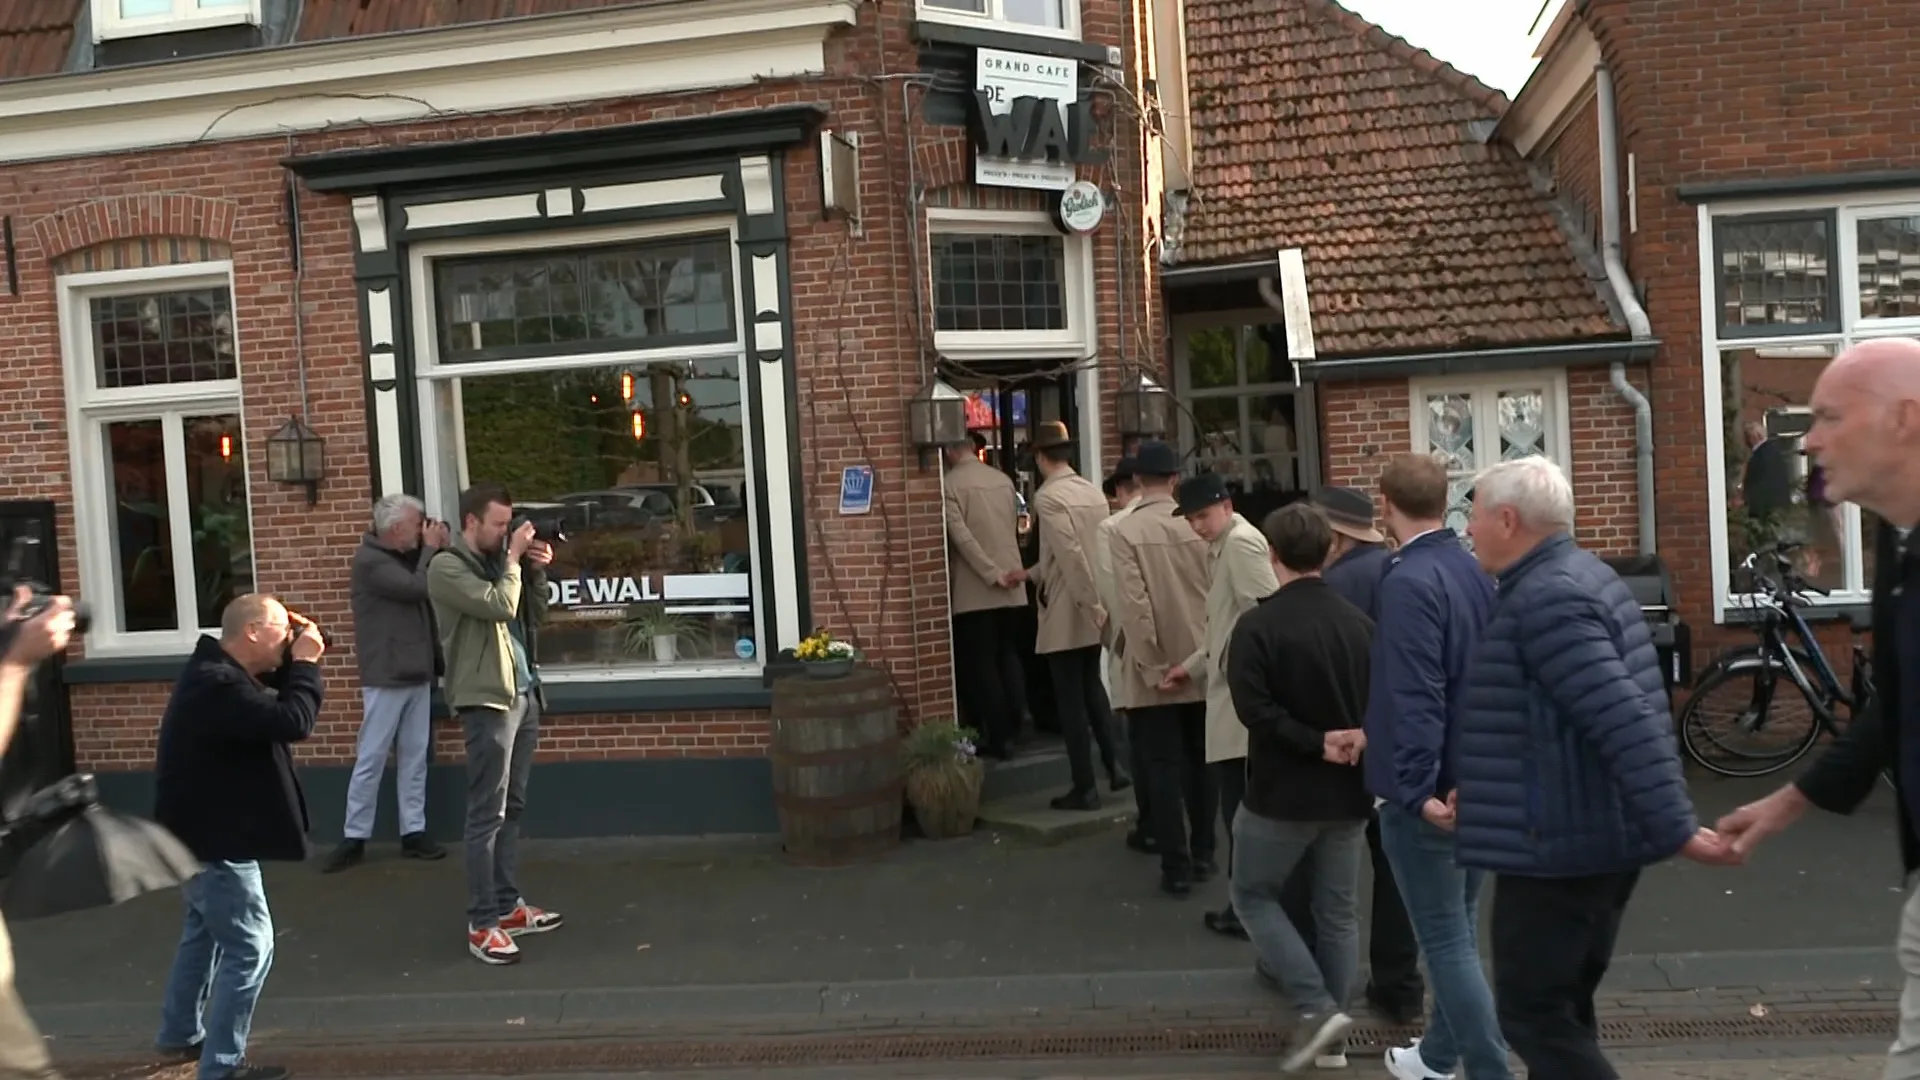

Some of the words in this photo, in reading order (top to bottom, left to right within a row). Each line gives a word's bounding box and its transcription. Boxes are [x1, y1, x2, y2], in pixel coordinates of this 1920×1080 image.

[985, 57, 1030, 72] GRAND
[1036, 65, 1069, 78] CAFE
[984, 84, 1005, 102] DE
[973, 90, 1111, 164] WAL
[1063, 190, 1099, 218] Grolsch
[547, 579, 581, 605] DE
[586, 575, 660, 603] WAL
